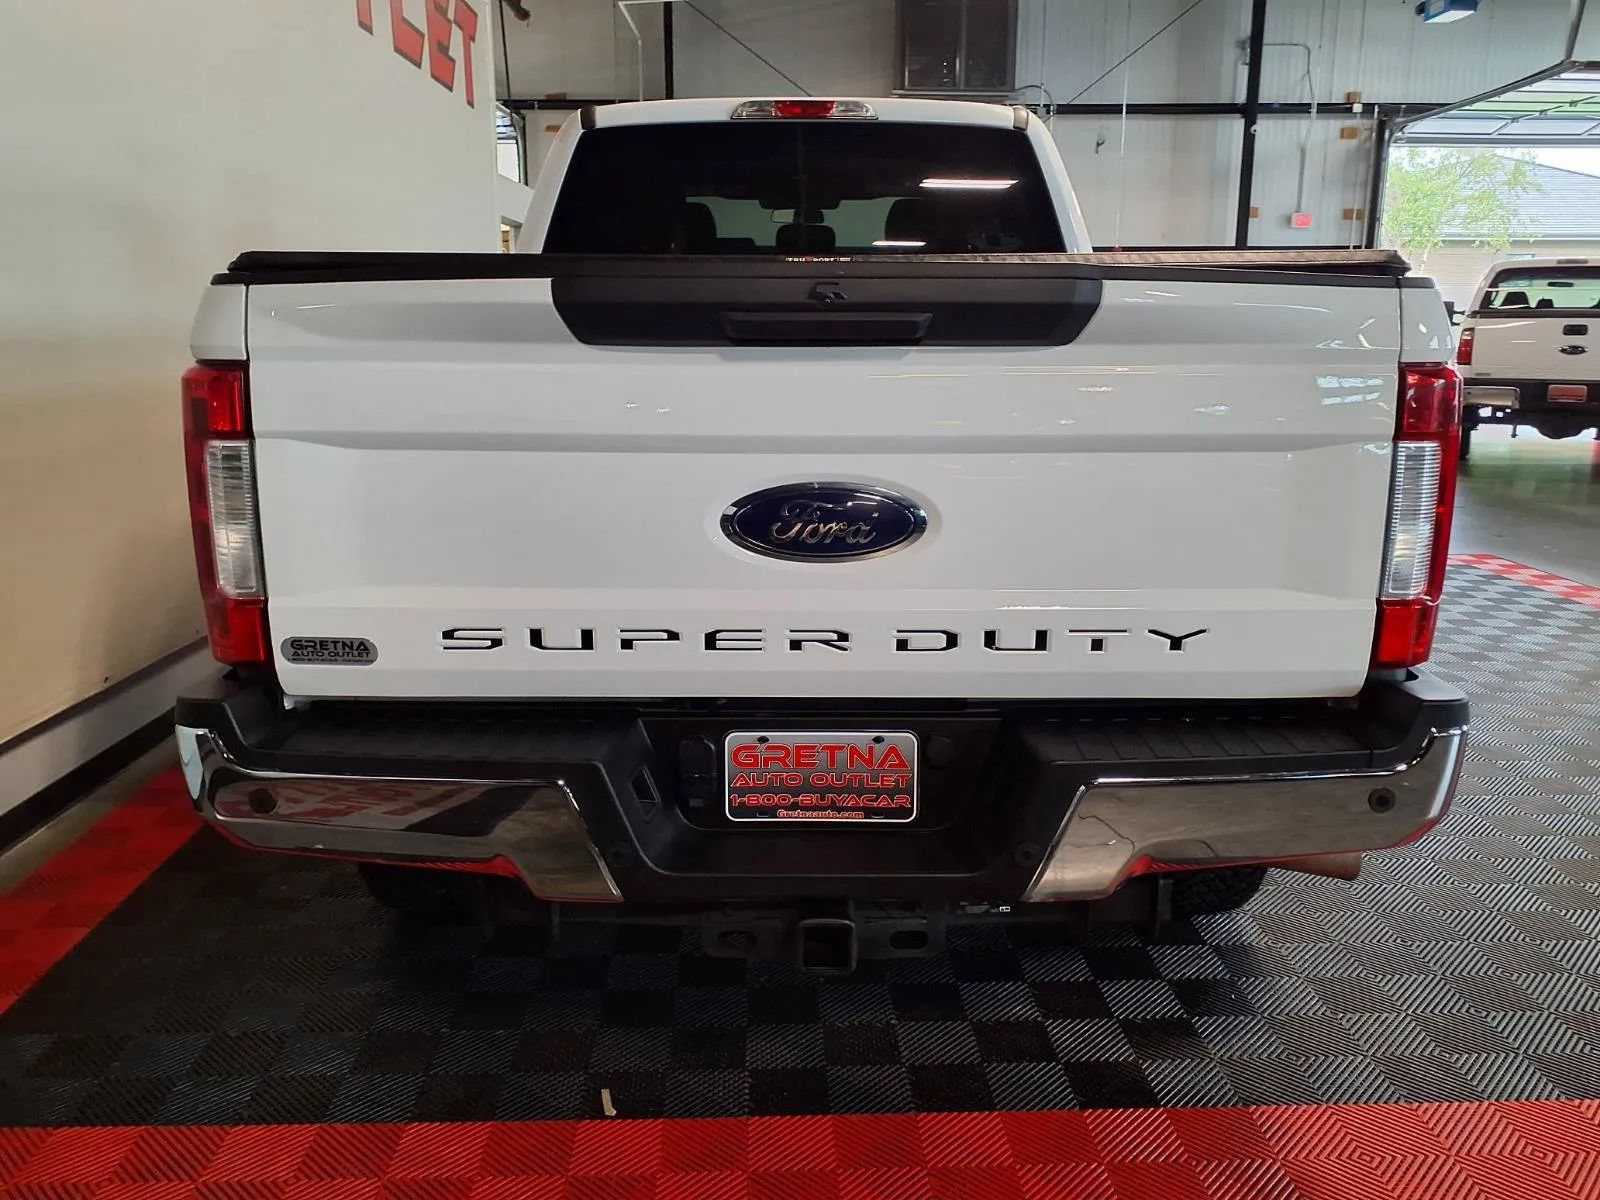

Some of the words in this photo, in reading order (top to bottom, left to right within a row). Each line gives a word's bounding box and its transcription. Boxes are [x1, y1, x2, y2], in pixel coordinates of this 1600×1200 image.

[771, 500, 879, 544] Ford
[290, 639, 370, 651] GRETNA
[441, 627, 850, 652] SUPER
[894, 628, 1210, 653] DUTY
[731, 743, 912, 770] GRETNA
[730, 772, 803, 788] AUTO
[810, 773, 912, 788] OUTLET
[730, 793, 911, 808] 1-800-BUYACAR
